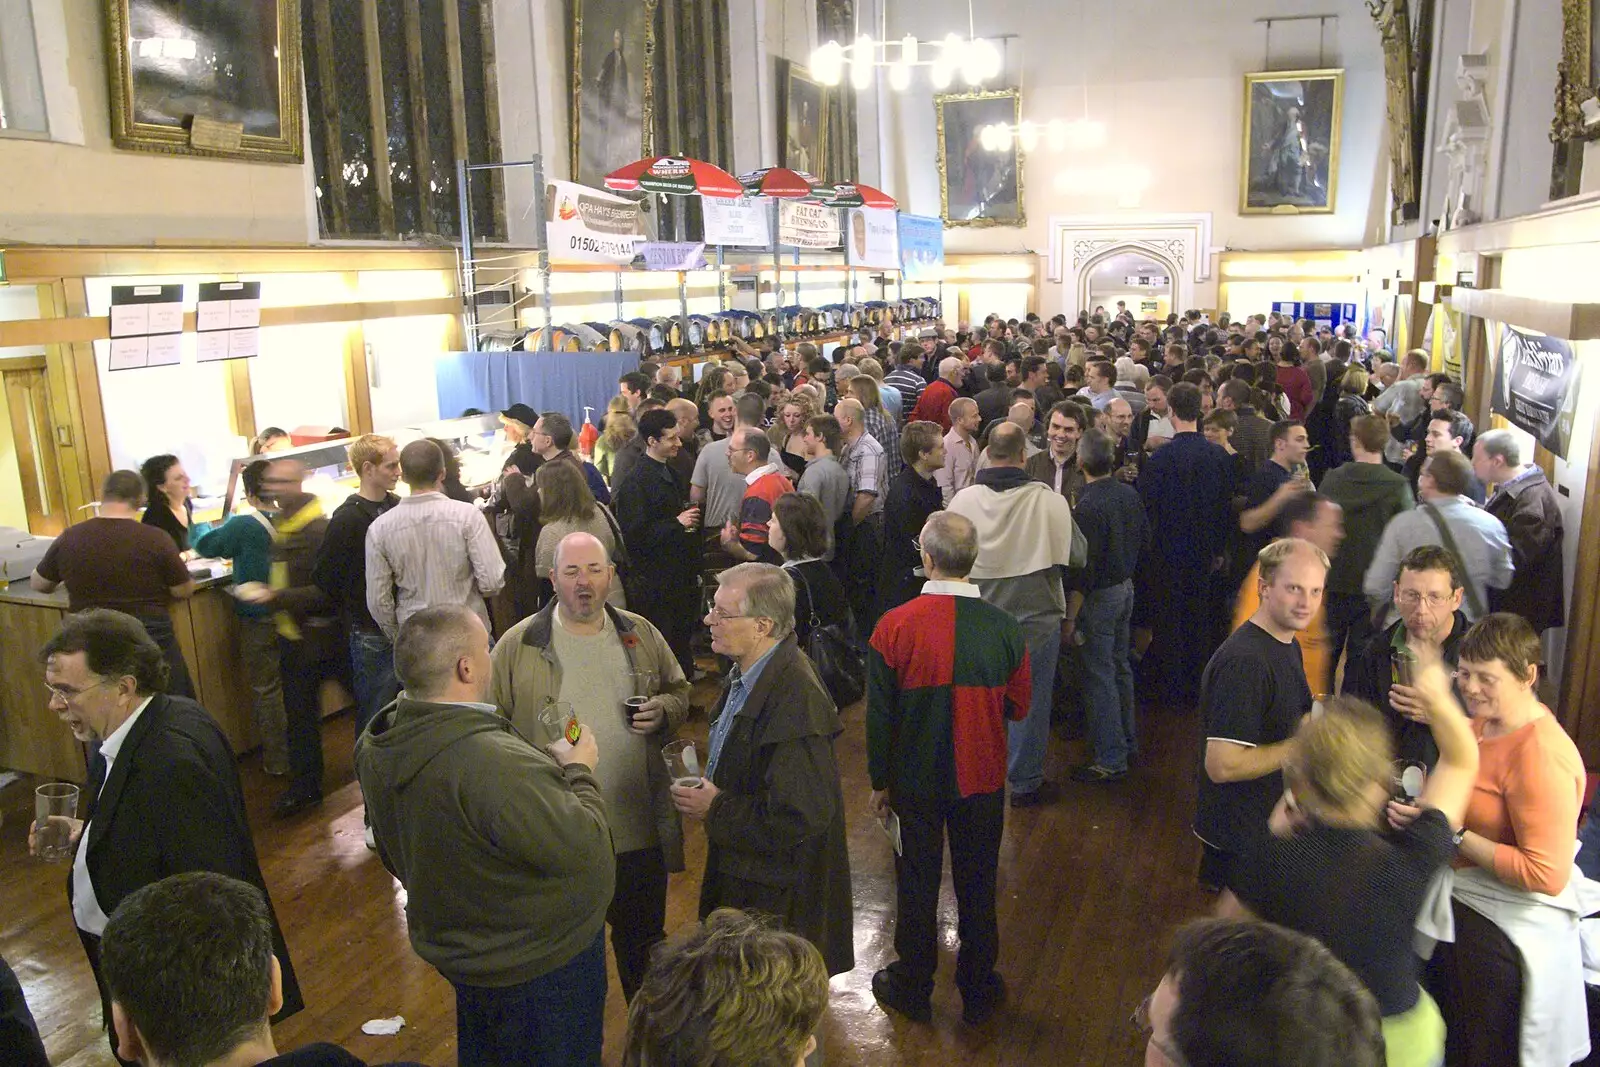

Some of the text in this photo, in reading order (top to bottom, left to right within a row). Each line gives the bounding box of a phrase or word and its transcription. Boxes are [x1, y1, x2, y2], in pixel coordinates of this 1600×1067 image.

[796, 206, 822, 218] FAT CAT
[570, 235, 600, 252] 01502
